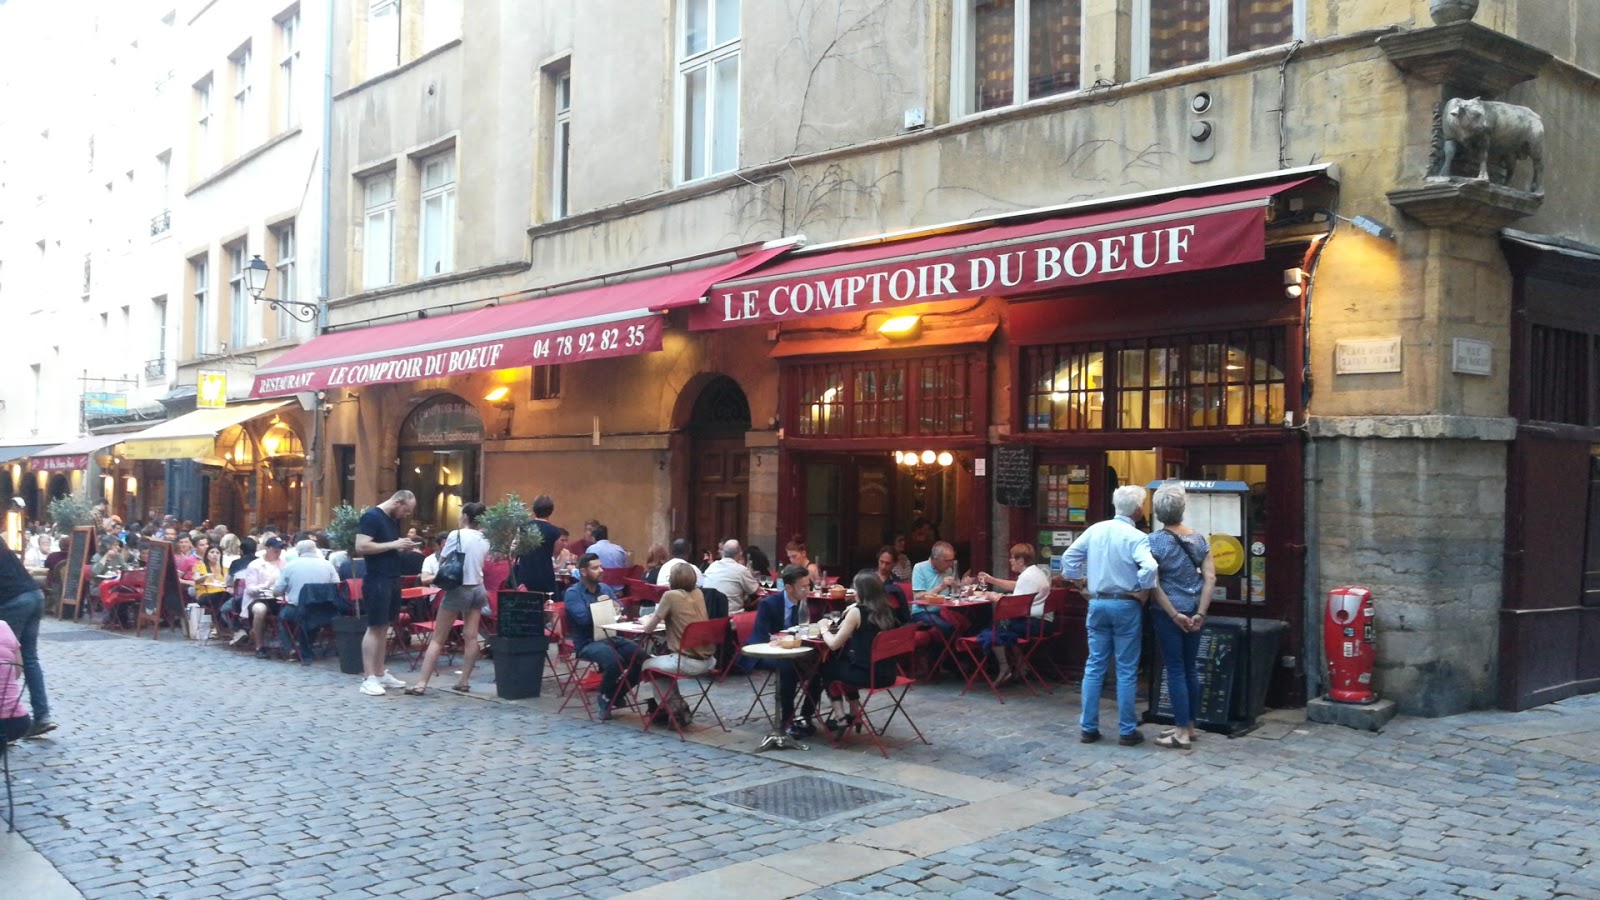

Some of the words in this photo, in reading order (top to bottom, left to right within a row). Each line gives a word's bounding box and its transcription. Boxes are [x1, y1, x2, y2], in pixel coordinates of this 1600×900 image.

[722, 290, 760, 323] LE
[768, 261, 958, 316] COMPTOIR
[967, 252, 1026, 292] DU
[1034, 225, 1196, 283] BOEUF
[533, 338, 551, 358] 04
[556, 335, 574, 356] 78
[578, 332, 596, 354] 92
[600, 329, 619, 350] 82
[625, 325, 646, 347] 35
[259, 372, 316, 394] RESTAURANT
[327, 367, 347, 386] LE
[348, 357, 423, 384] COMPTOIR
[425, 355, 448, 376] DU
[448, 344, 504, 371] BOEUF
